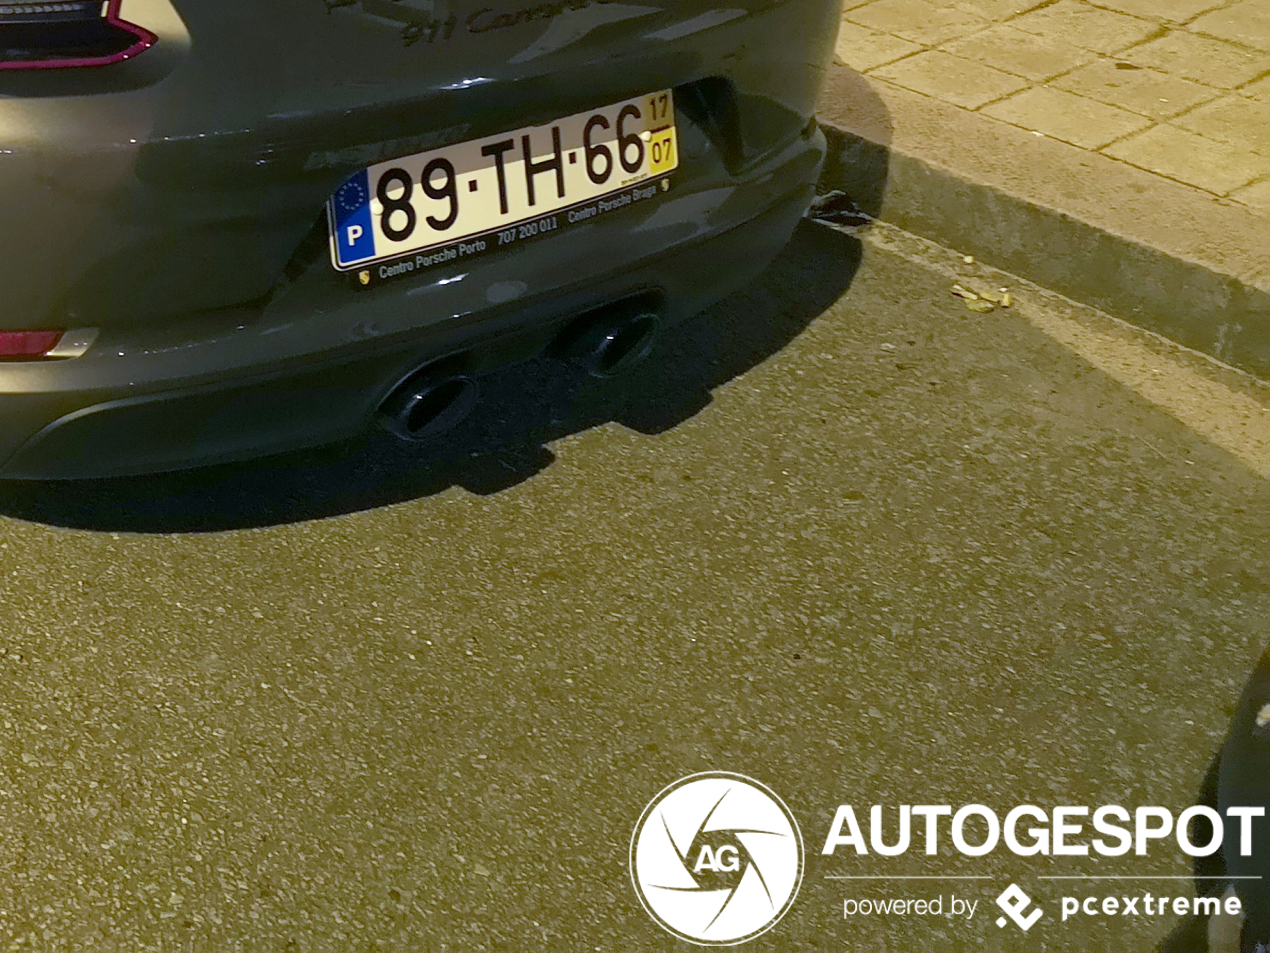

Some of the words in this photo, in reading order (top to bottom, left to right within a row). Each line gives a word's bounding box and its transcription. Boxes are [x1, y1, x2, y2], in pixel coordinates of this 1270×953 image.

[400, 12, 457, 47] 911
[650, 93, 668, 121] 17
[651, 137, 672, 165] 07
[347, 224, 363, 246] P
[379, 256, 414, 279] Centro
[415, 247, 457, 269] Porsche
[458, 238, 486, 257] Porto
[497, 230, 517, 246] 707
[518, 224, 538, 240] 200
[539, 217, 558, 234] 011
[568, 205, 597, 224] Centro
[598, 195, 632, 215] Porsche
[633, 184, 657, 202] Braga
